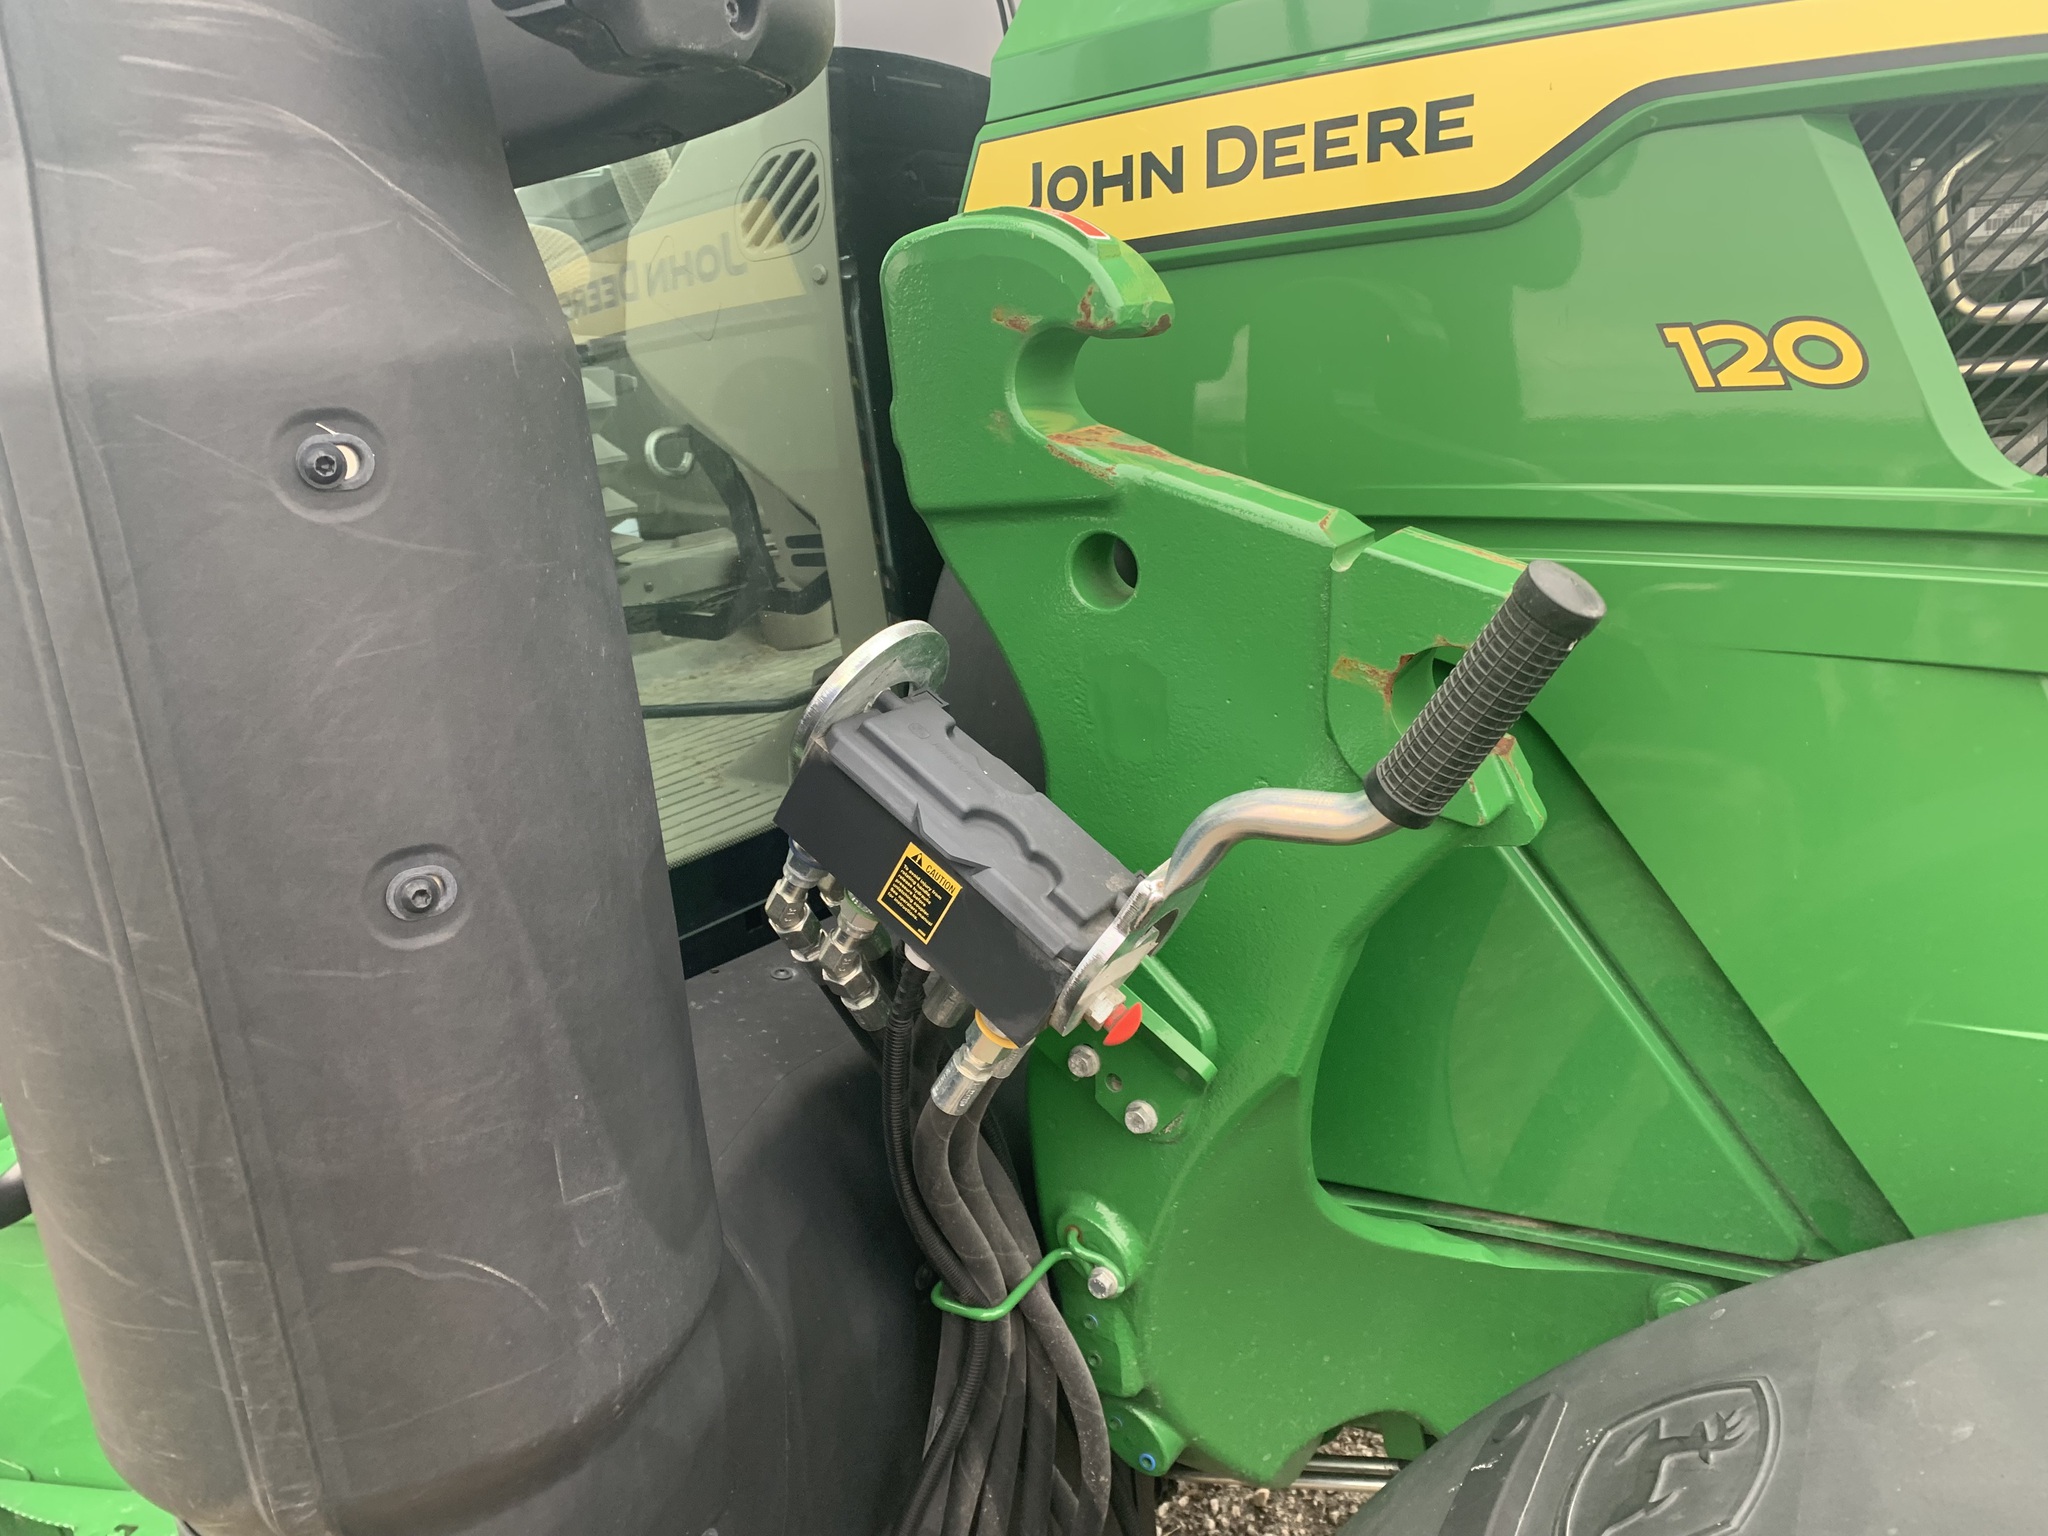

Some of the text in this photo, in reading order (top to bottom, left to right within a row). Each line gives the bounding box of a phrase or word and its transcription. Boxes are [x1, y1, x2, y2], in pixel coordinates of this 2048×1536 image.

[1029, 93, 1475, 213] JOHN DEERE
[1656, 315, 1870, 393] 120
[920, 880, 933, 891] injury
[932, 890, 942, 900] from
[926, 864, 956, 894] CAUTION
